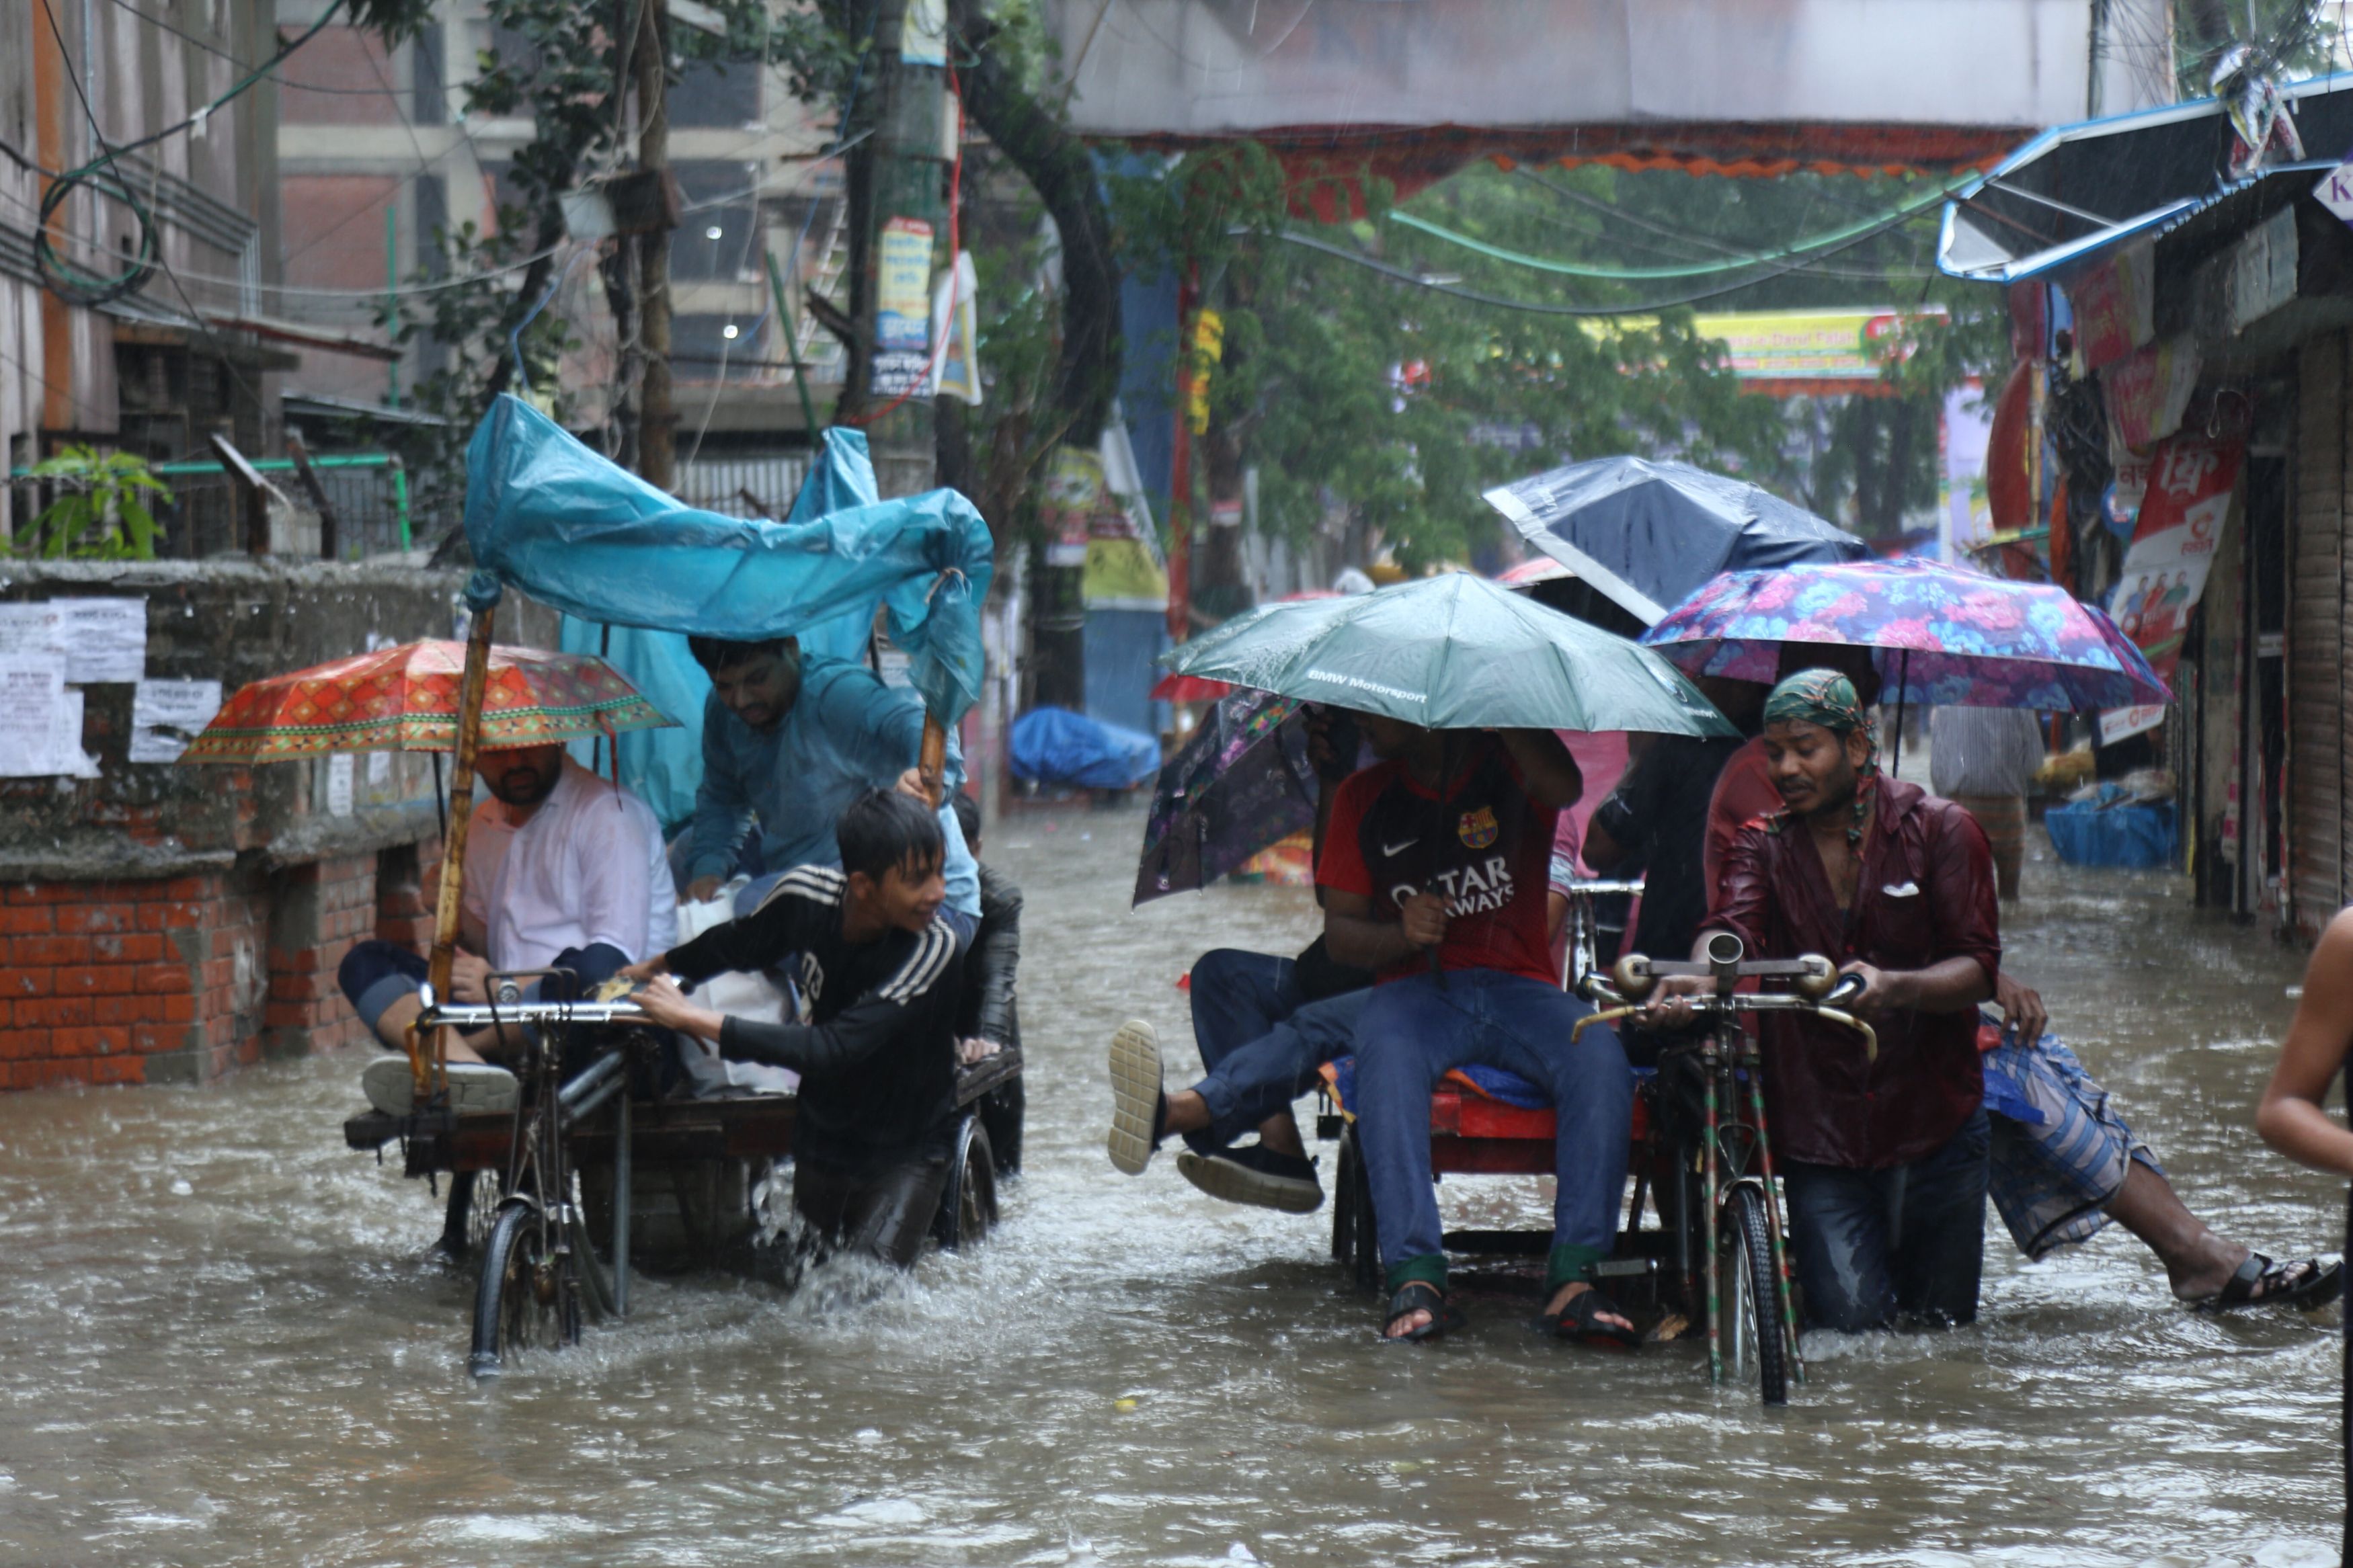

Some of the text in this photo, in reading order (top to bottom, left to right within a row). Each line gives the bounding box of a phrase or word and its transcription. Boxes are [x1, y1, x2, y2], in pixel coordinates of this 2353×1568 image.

[1308, 669, 1428, 704] BMW Motorsport
[1391, 856, 1512, 909] QTAR
